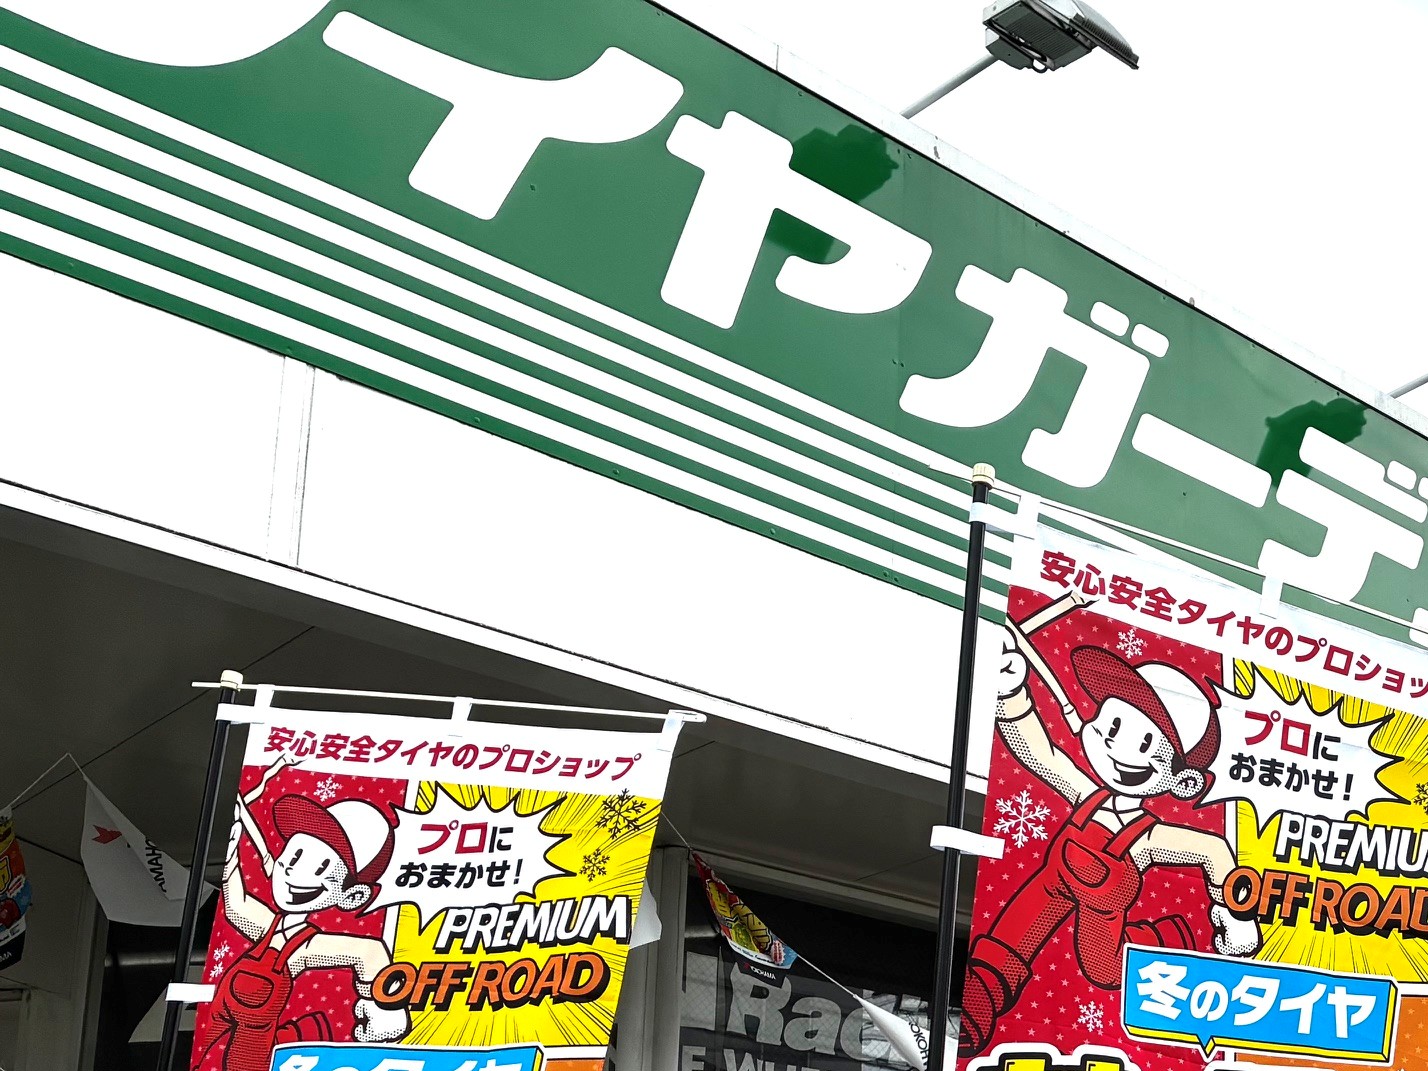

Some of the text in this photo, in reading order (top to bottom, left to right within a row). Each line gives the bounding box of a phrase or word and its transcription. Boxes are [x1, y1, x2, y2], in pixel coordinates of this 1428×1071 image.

[265, 726, 641, 780] 安心安全タイヤのプロショップ
[1244, 710, 1339, 762] プロに
[418, 820, 512, 855] プロに
[436, 897, 630, 952] PREMIUM
[1137, 961, 1377, 1039] 冬のタイヤ
